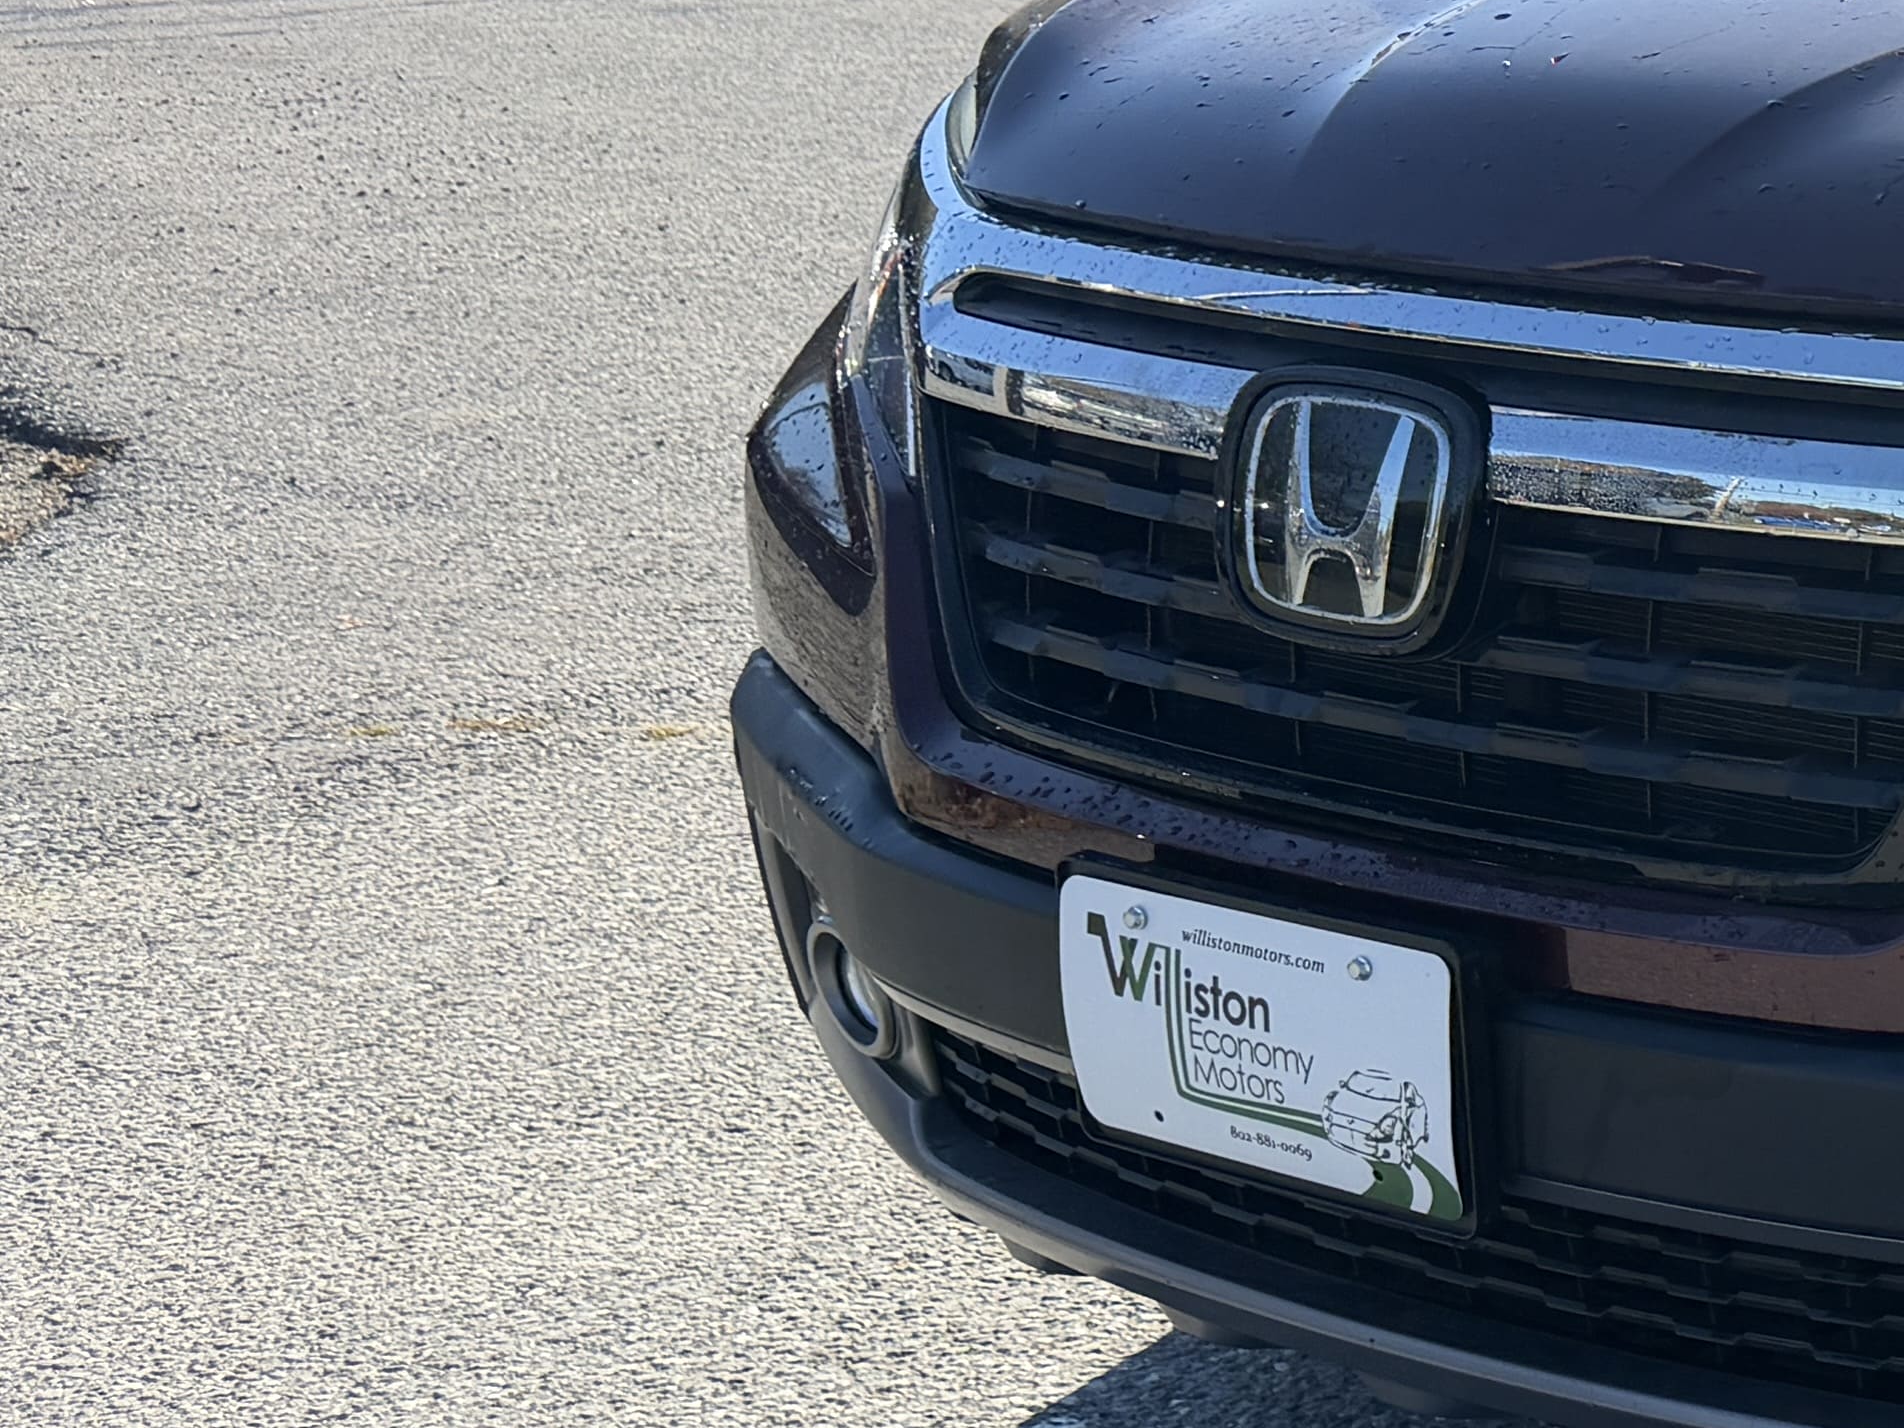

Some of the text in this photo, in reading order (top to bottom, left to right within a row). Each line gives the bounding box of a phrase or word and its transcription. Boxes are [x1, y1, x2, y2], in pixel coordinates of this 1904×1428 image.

[1087, 911, 1270, 1033] Williston
[1182, 928, 1325, 974] willistonmotors.com
[1188, 1018, 1314, 1084] Economy
[1194, 1058, 1285, 1104] Motors
[1230, 1126, 1313, 1162] 802-881-0069
